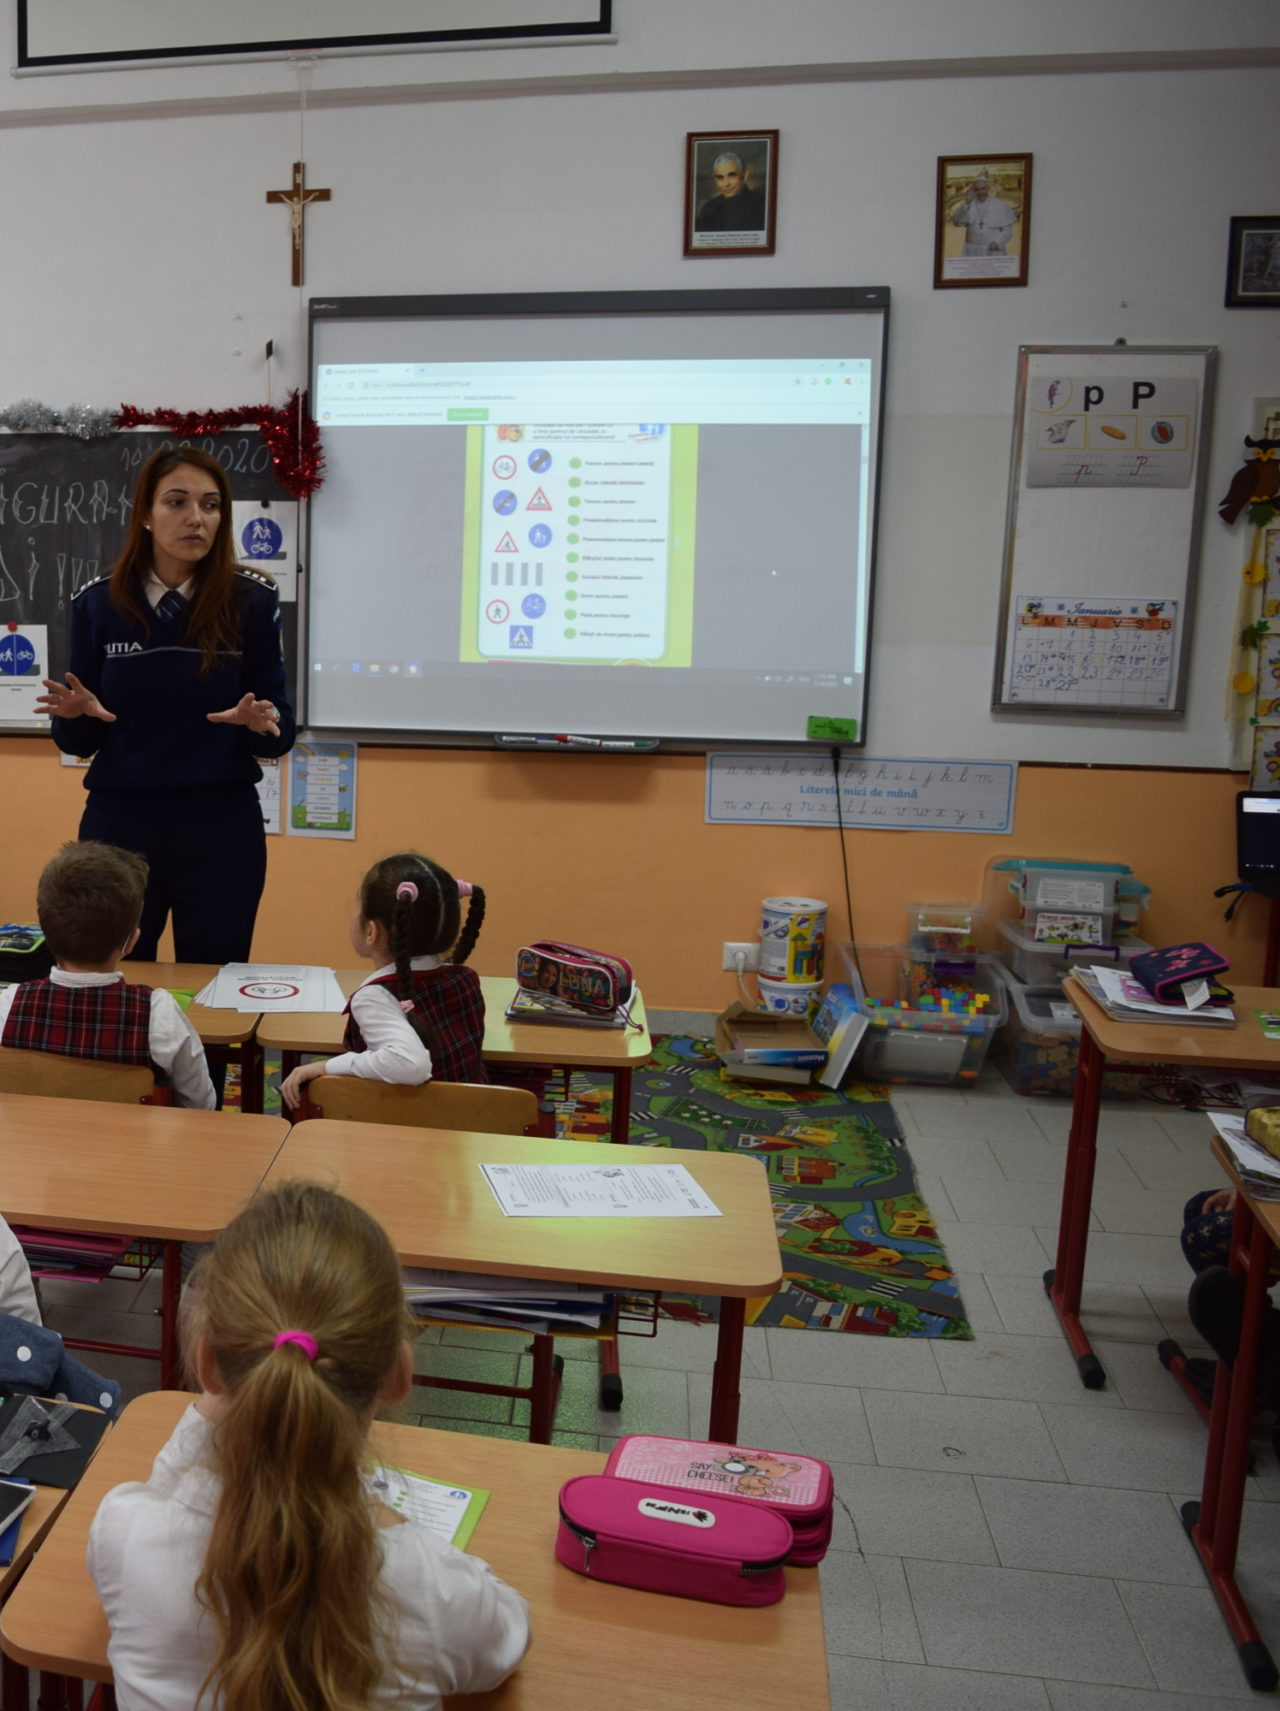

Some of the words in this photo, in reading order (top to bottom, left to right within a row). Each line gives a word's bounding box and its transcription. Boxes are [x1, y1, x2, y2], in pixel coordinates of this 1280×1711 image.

[1083, 385, 1104, 412] p
[1131, 382, 1156, 409] P
[843, 786, 867, 796] mici
[871, 787, 882, 797] de
[887, 788, 918, 798] mână
[691, 1462, 712, 1470] SAY
[687, 1470, 734, 1483] CHEESE!
